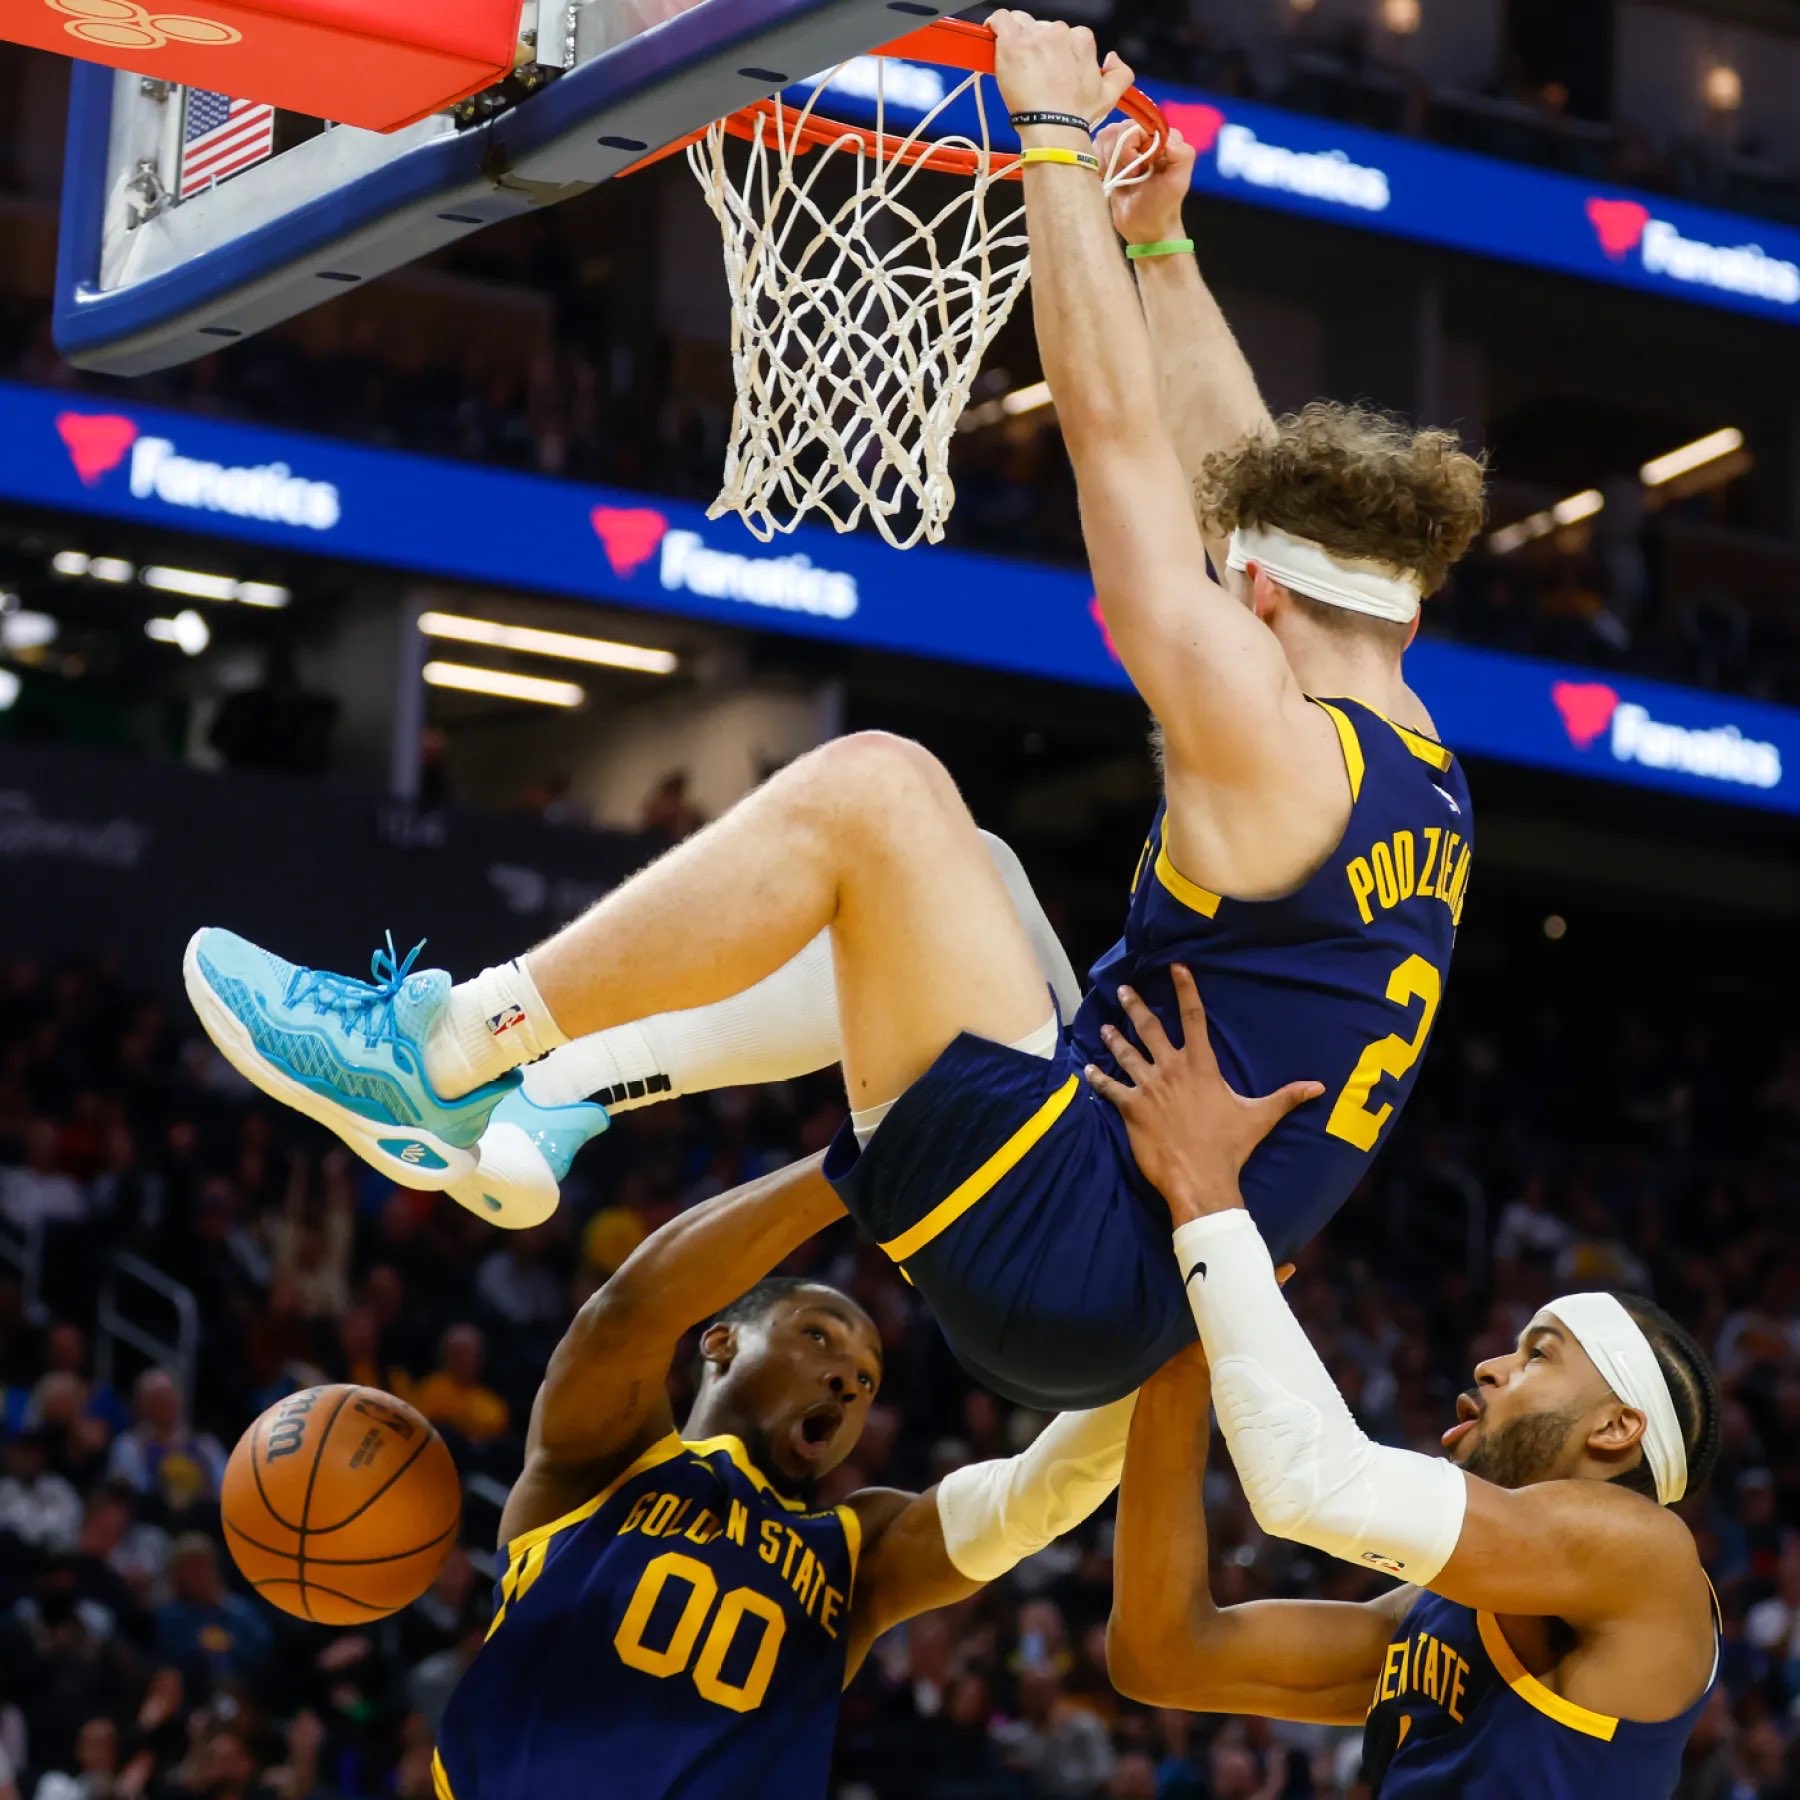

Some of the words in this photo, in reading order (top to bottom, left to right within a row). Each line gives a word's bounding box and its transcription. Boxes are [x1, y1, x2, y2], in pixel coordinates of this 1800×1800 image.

[1040, 114, 1069, 123] NAME
[1218, 124, 1388, 210] Fanatics
[1642, 219, 1800, 303] Fanatics
[131, 437, 340, 529] Fanatics
[660, 529, 858, 619] Fanatics
[1612, 703, 1781, 787] Fanatics
[1326, 954, 1441, 1152] 2
[759, 1519, 844, 1641] STATE
[613, 1552, 787, 1713] 00
